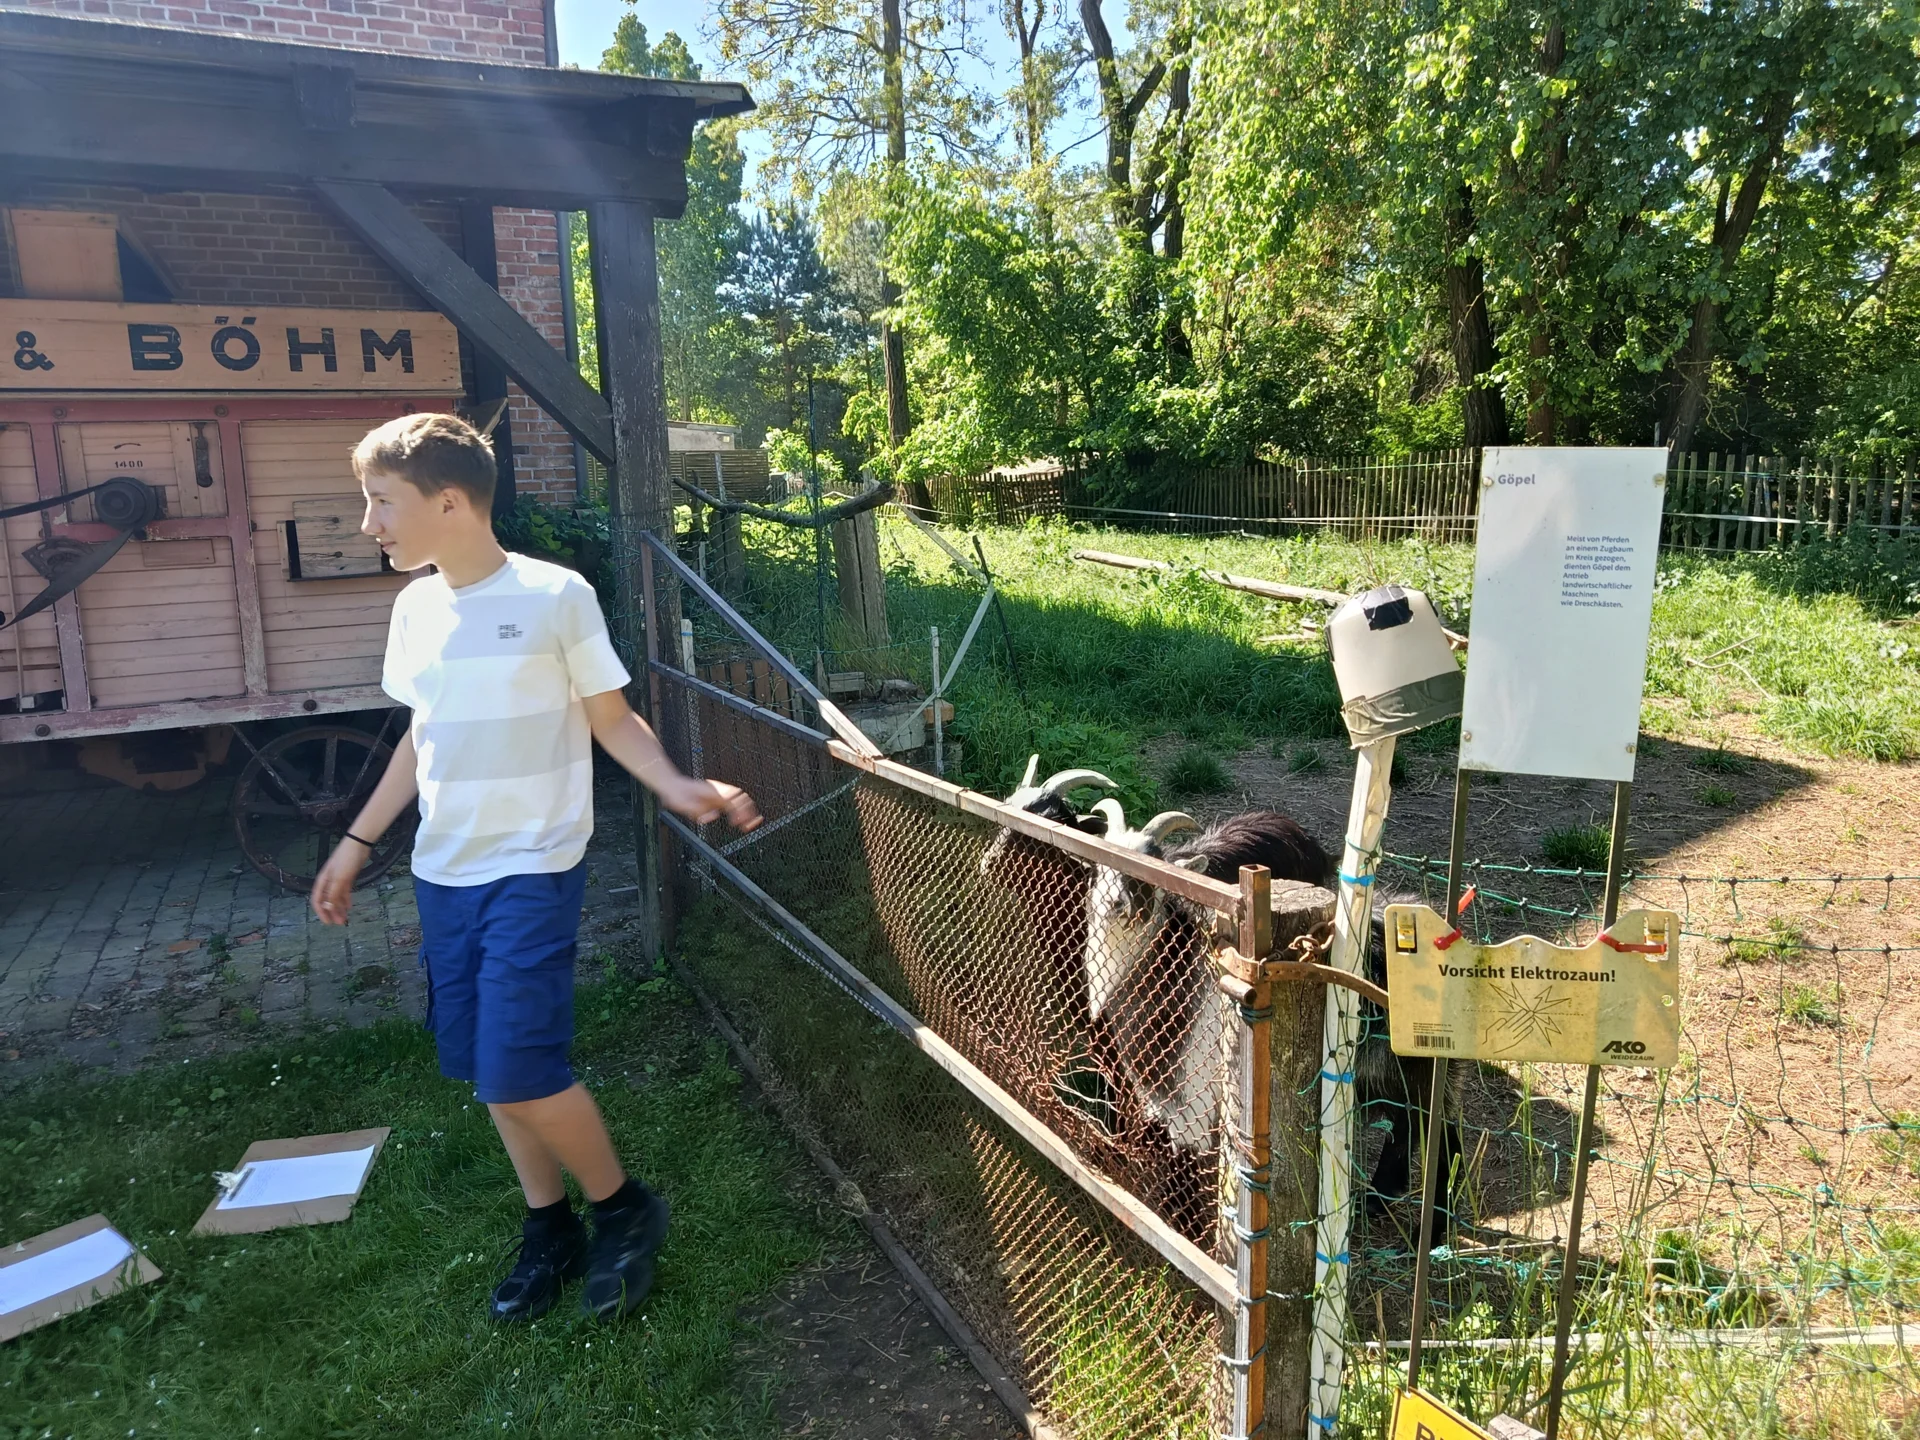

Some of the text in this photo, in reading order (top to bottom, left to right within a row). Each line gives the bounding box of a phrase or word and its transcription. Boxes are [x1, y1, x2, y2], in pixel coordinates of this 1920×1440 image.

[14, 316, 414, 373] & BÖHM
[114, 460, 143, 468] 1400
[1497, 474, 1536, 486] Göpel
[1566, 535, 1586, 543] Meist
[1562, 581, 1633, 590] landwirtschaftlicher
[1561, 590, 1599, 598] Maschinen
[1574, 600, 1624, 608] Dreschkästen.
[1438, 964, 1616, 983] Vorsicht Elektrozaun!
[1600, 1040, 1646, 1054] AKO
